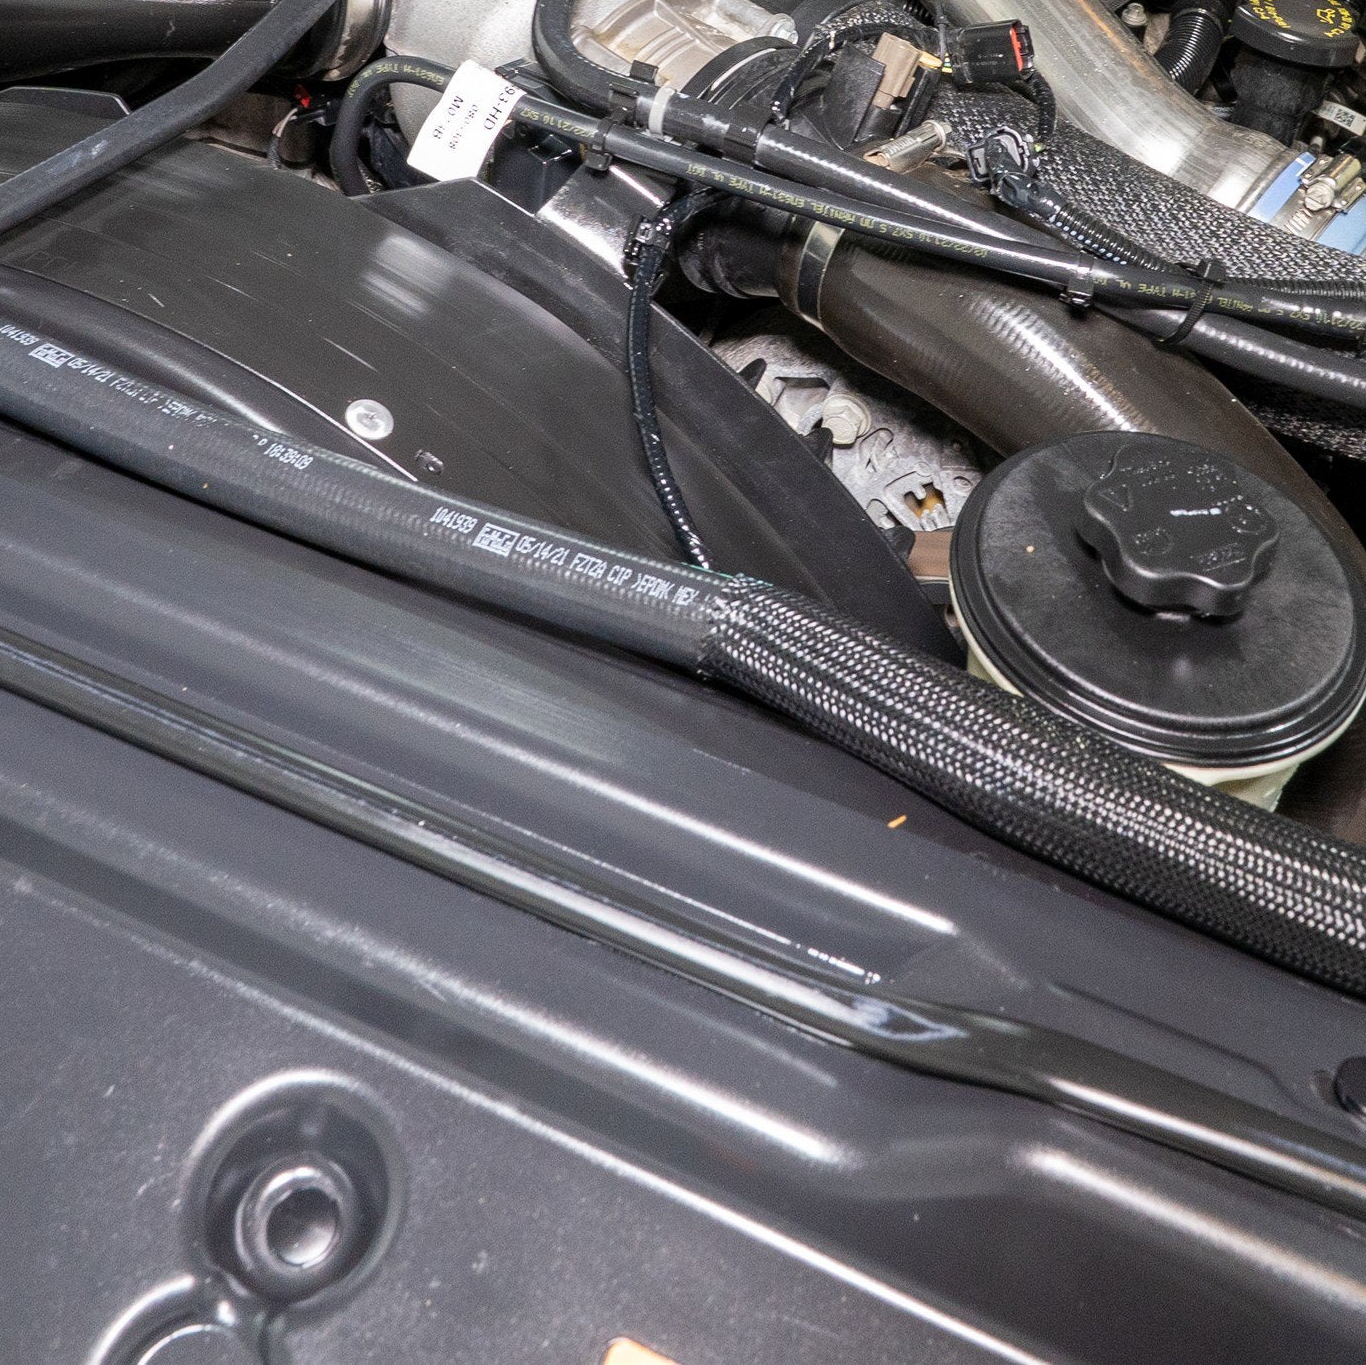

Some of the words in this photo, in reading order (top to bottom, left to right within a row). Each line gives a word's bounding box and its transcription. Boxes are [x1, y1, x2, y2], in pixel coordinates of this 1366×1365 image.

[265, 442, 310, 469] 18:39:09
[431, 507, 476, 534] 1041939
[515, 535, 569, 565] 05/14/21
